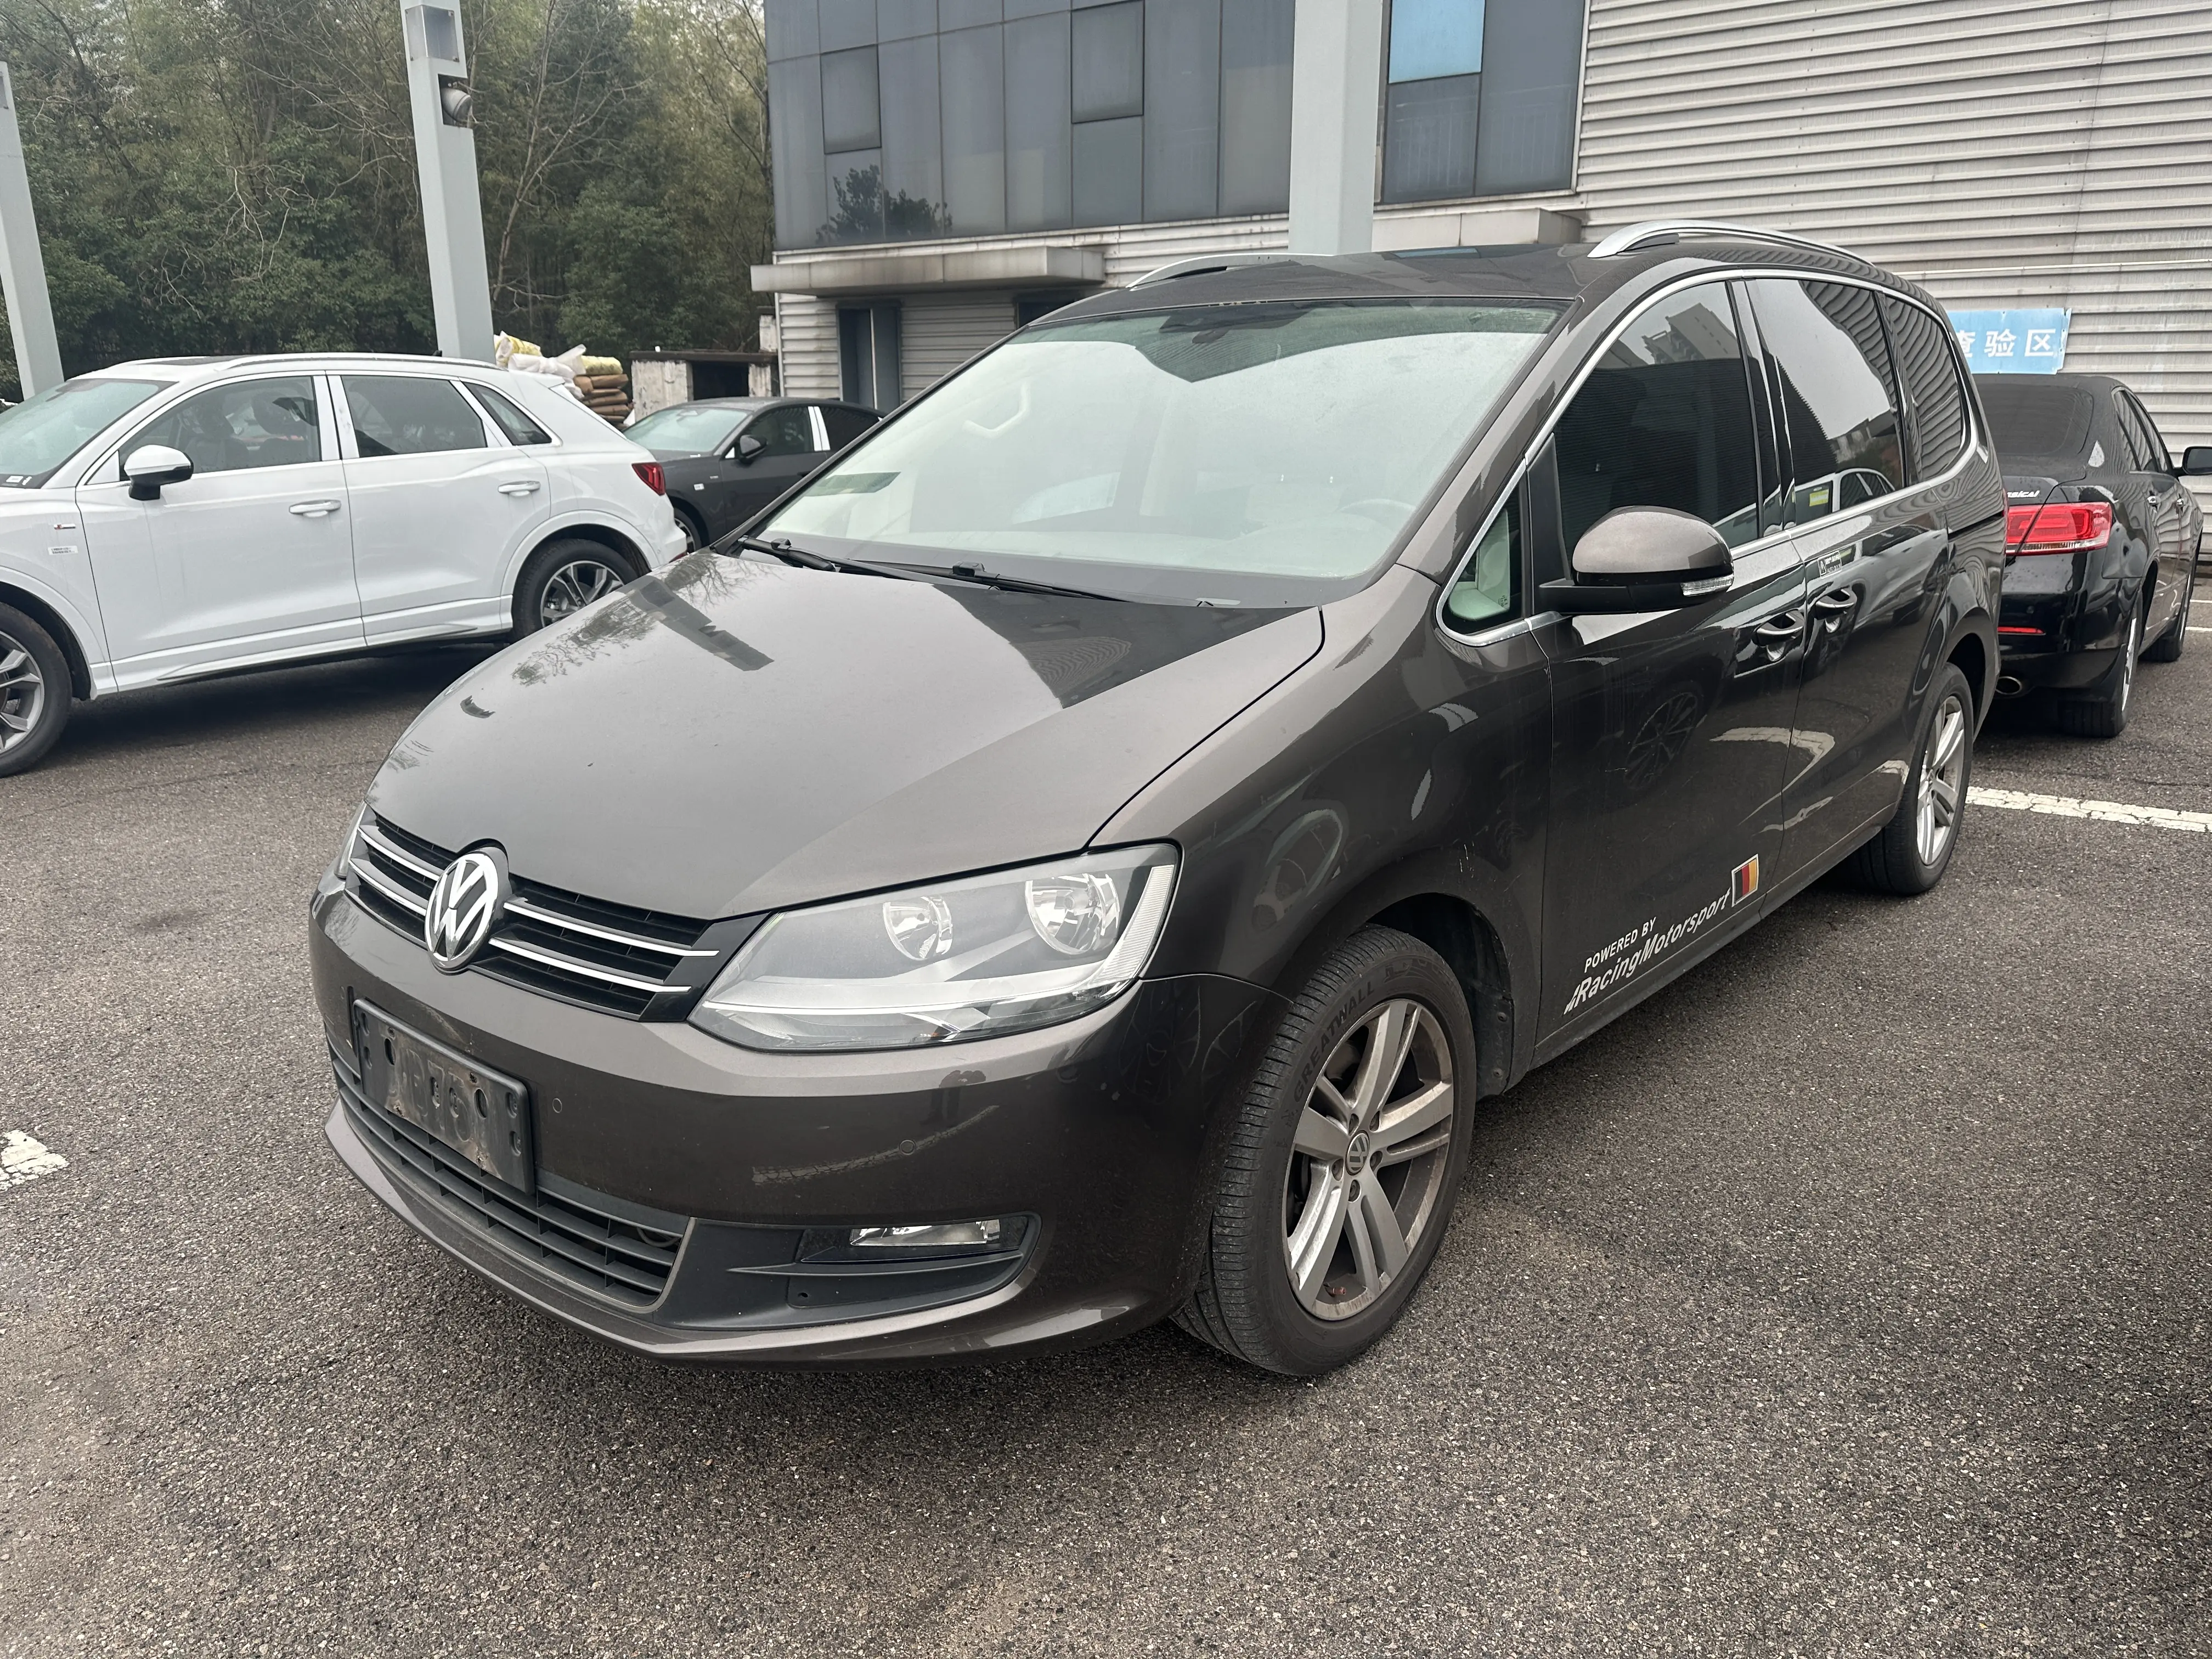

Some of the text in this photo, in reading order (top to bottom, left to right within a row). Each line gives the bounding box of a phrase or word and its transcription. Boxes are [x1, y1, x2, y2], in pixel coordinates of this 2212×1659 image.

[1955, 329, 2056, 358] 查验区
[1584, 917, 1656, 973] POWERED BY
[1294, 981, 1374, 1103] GREATWALL
